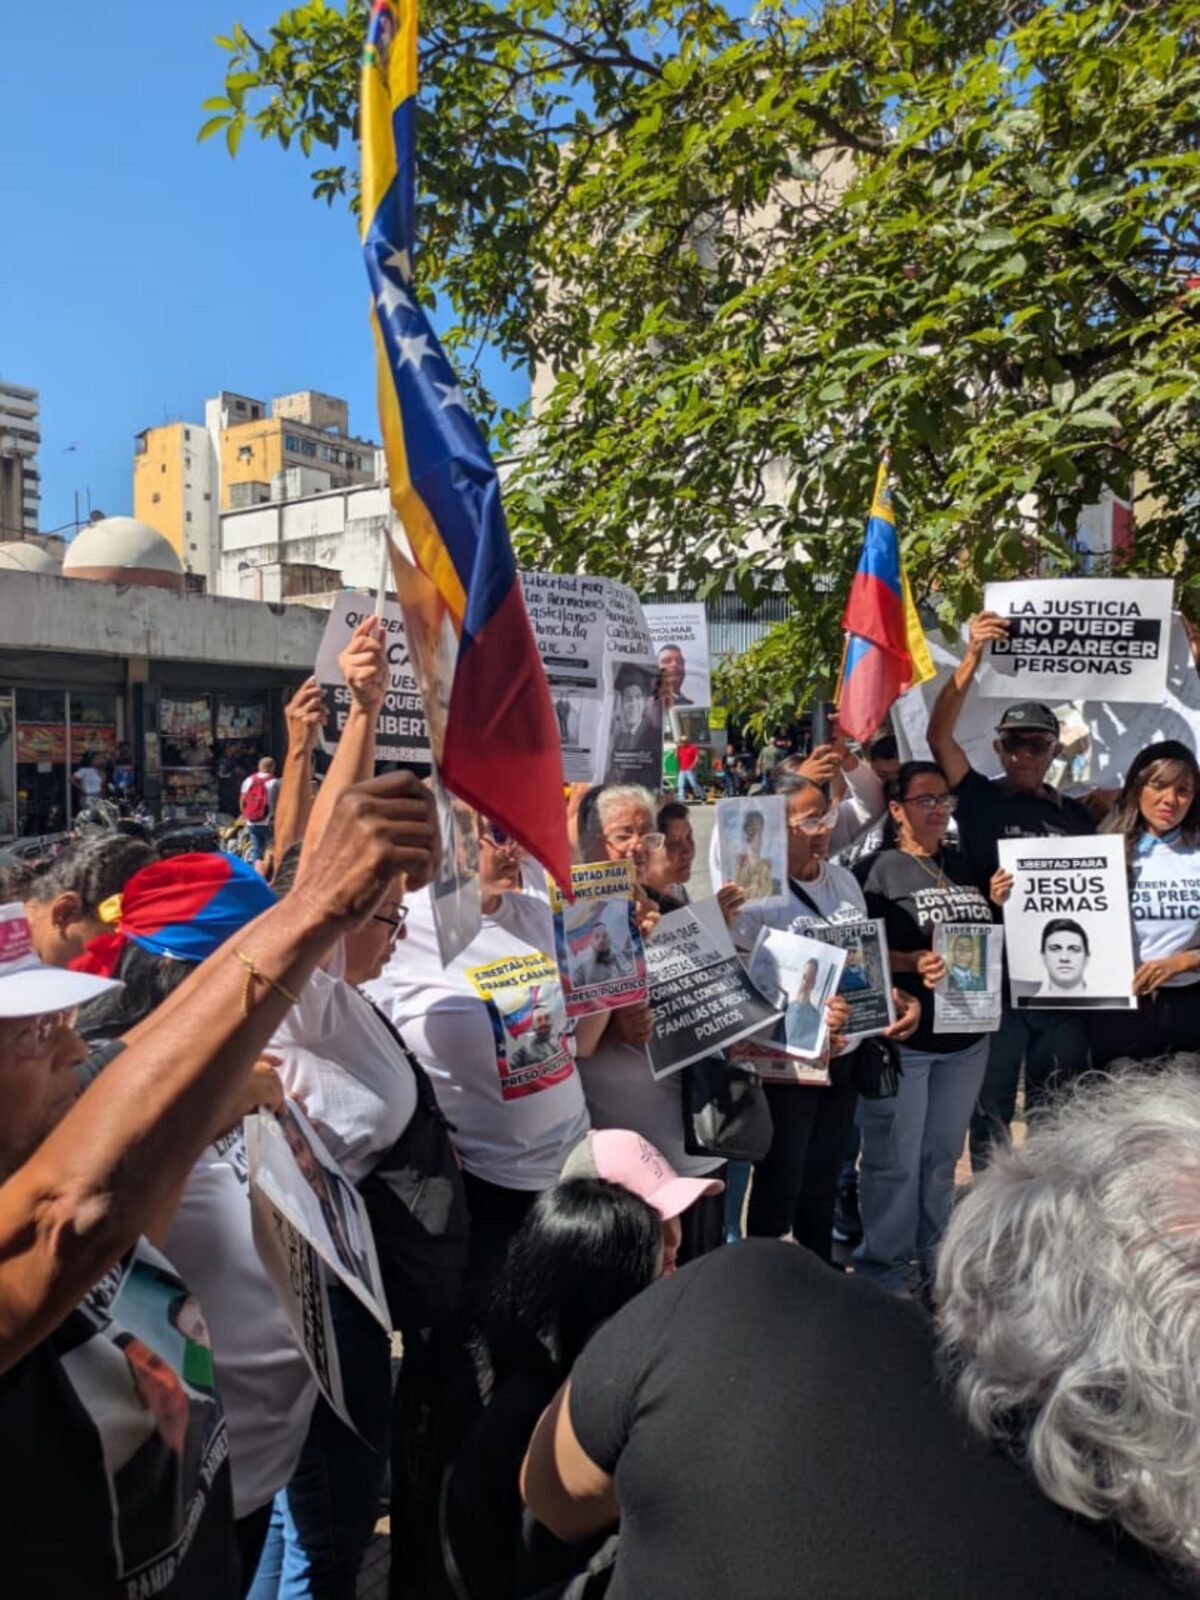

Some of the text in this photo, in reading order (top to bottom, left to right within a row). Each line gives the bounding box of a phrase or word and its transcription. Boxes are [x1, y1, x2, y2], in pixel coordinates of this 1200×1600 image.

[1009, 601, 1142, 617] LA JUSTICIA
[1019, 619, 1136, 637] NO PUEDE
[994, 638, 1158, 658] DESAPARECER
[1013, 657, 1133, 675] PERSONAS
[1018, 857, 1106, 870] LIBERTAD PARA
[571, 869, 603, 882] ERTAD
[1023, 872, 1106, 895] JESÚS
[1022, 895, 1109, 913] ARMAS
[1132, 902, 1200, 921] OLÍTIC
[675, 921, 701, 941] QUE
[945, 926, 993, 936] LIBERTAD
